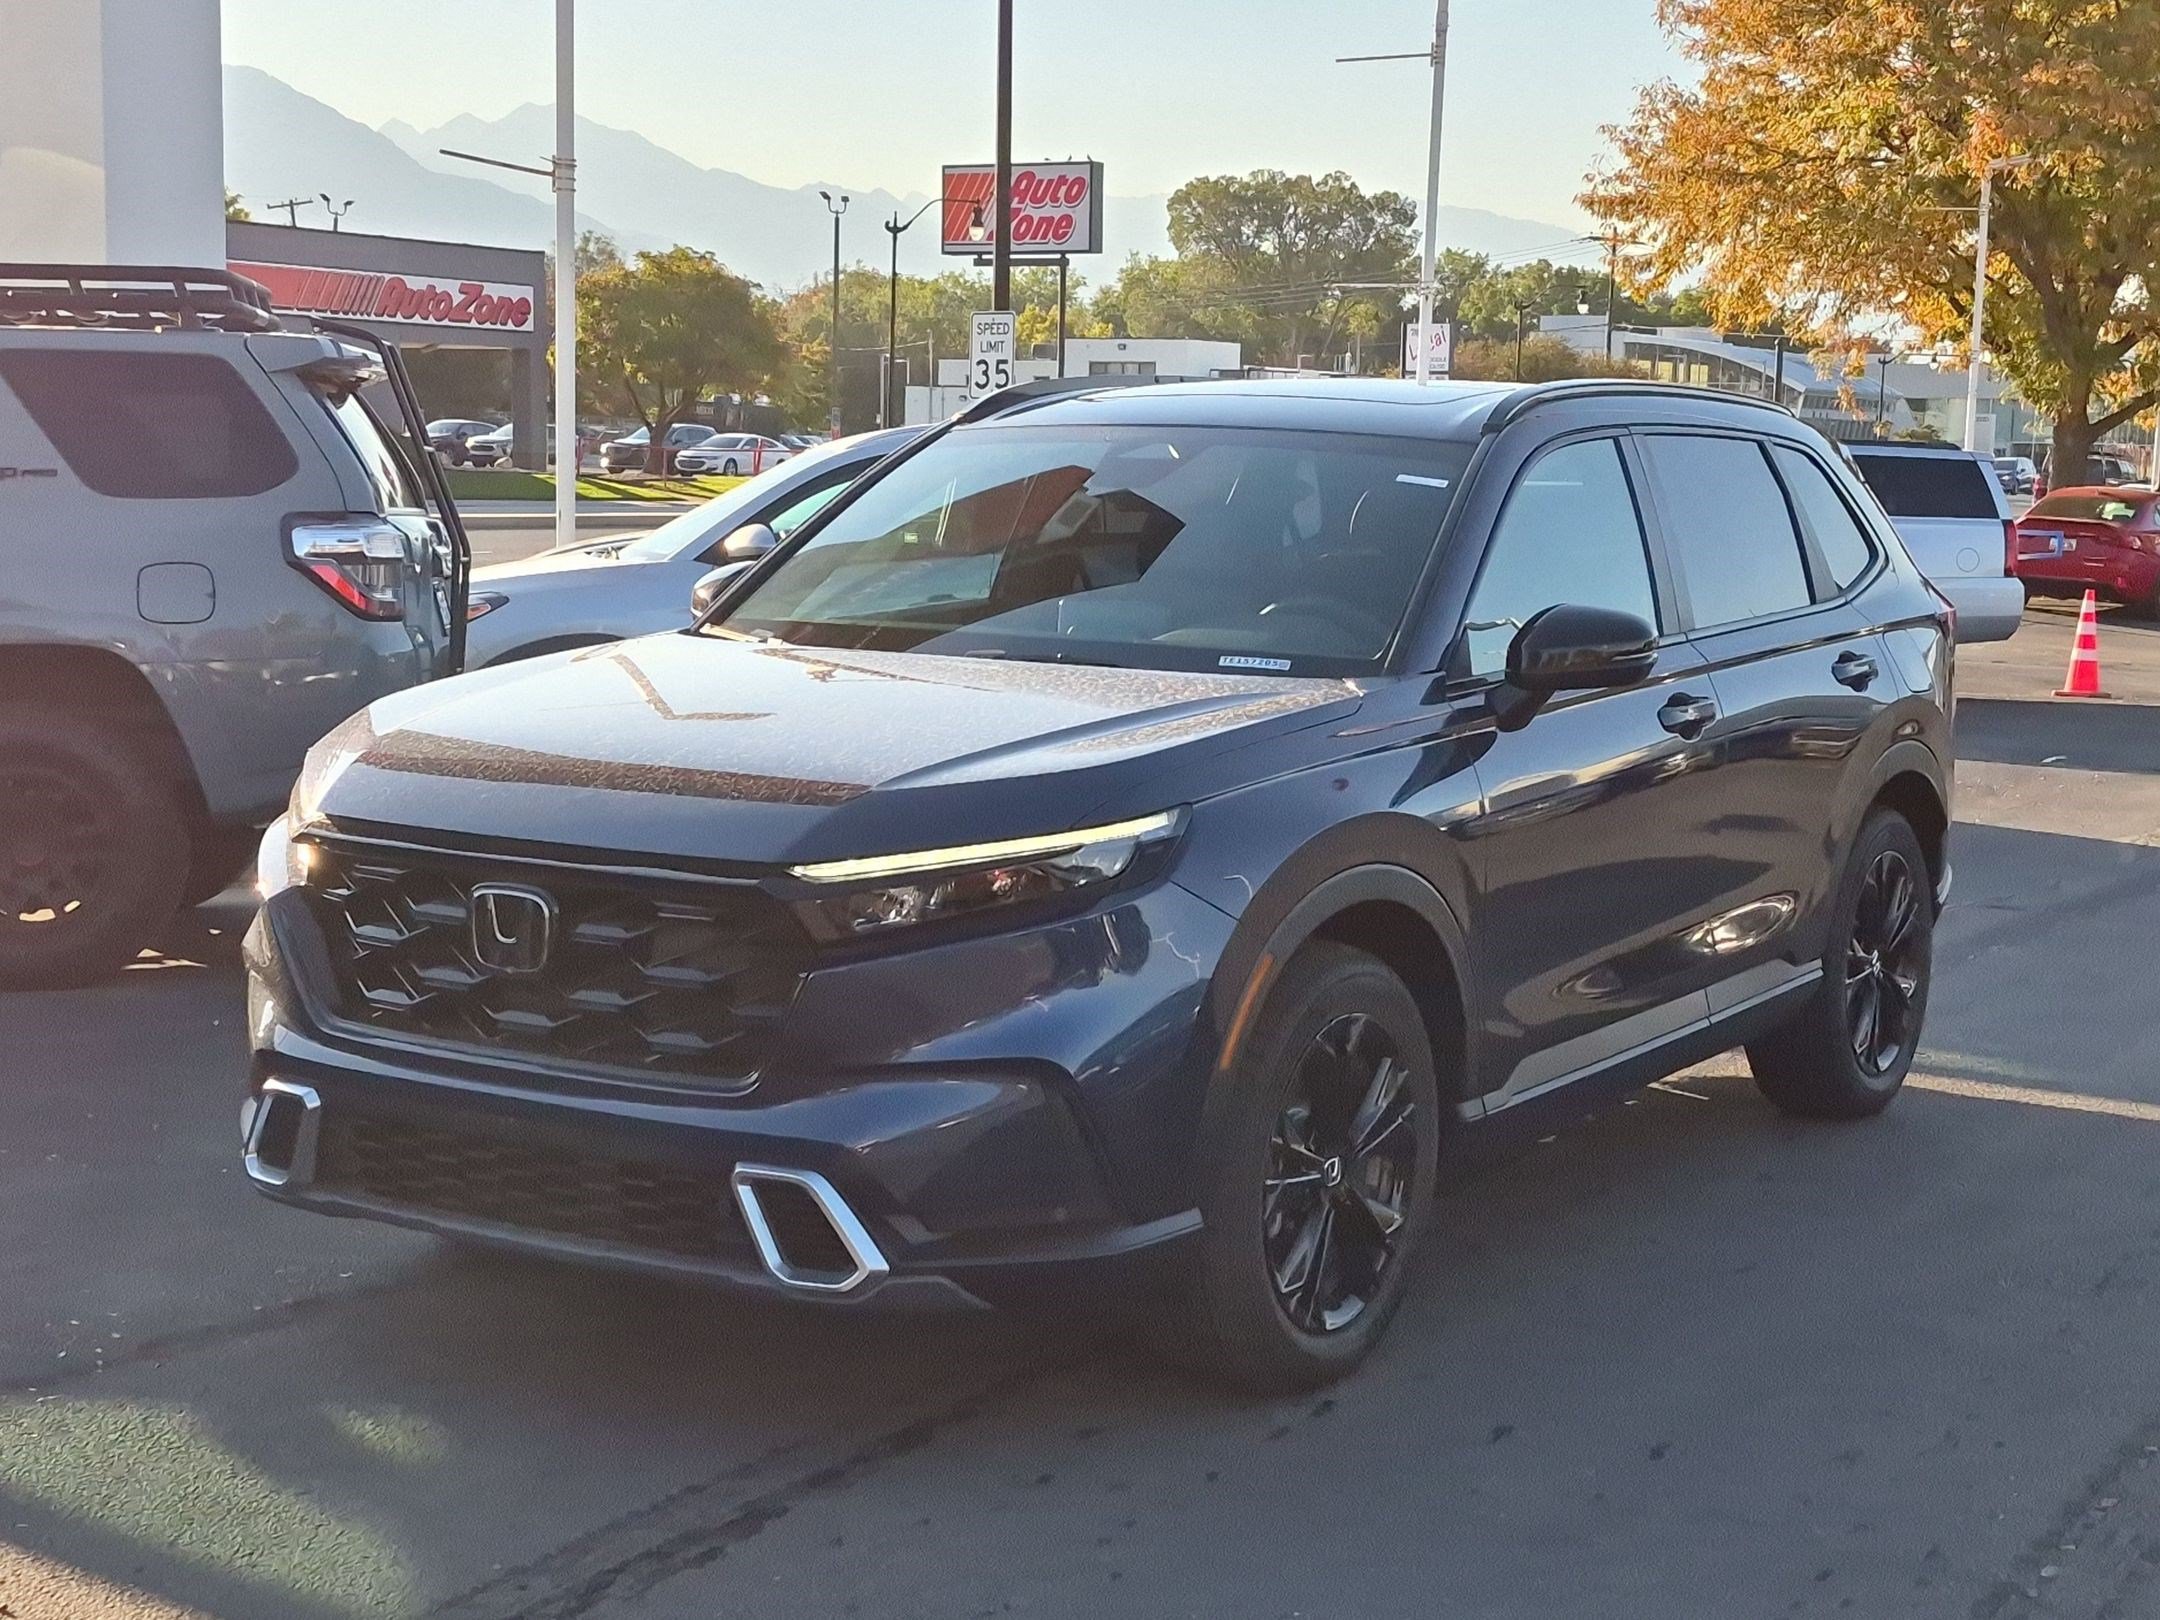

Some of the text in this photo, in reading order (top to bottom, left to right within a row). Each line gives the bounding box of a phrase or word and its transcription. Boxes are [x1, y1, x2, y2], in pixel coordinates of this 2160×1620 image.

[1010, 170, 1087, 206] Auto
[374, 276, 532, 328] AutoZone
[976, 322, 1010, 336] SPEED
[980, 340, 1005, 353] LIMIT
[974, 359, 1010, 390] 35
